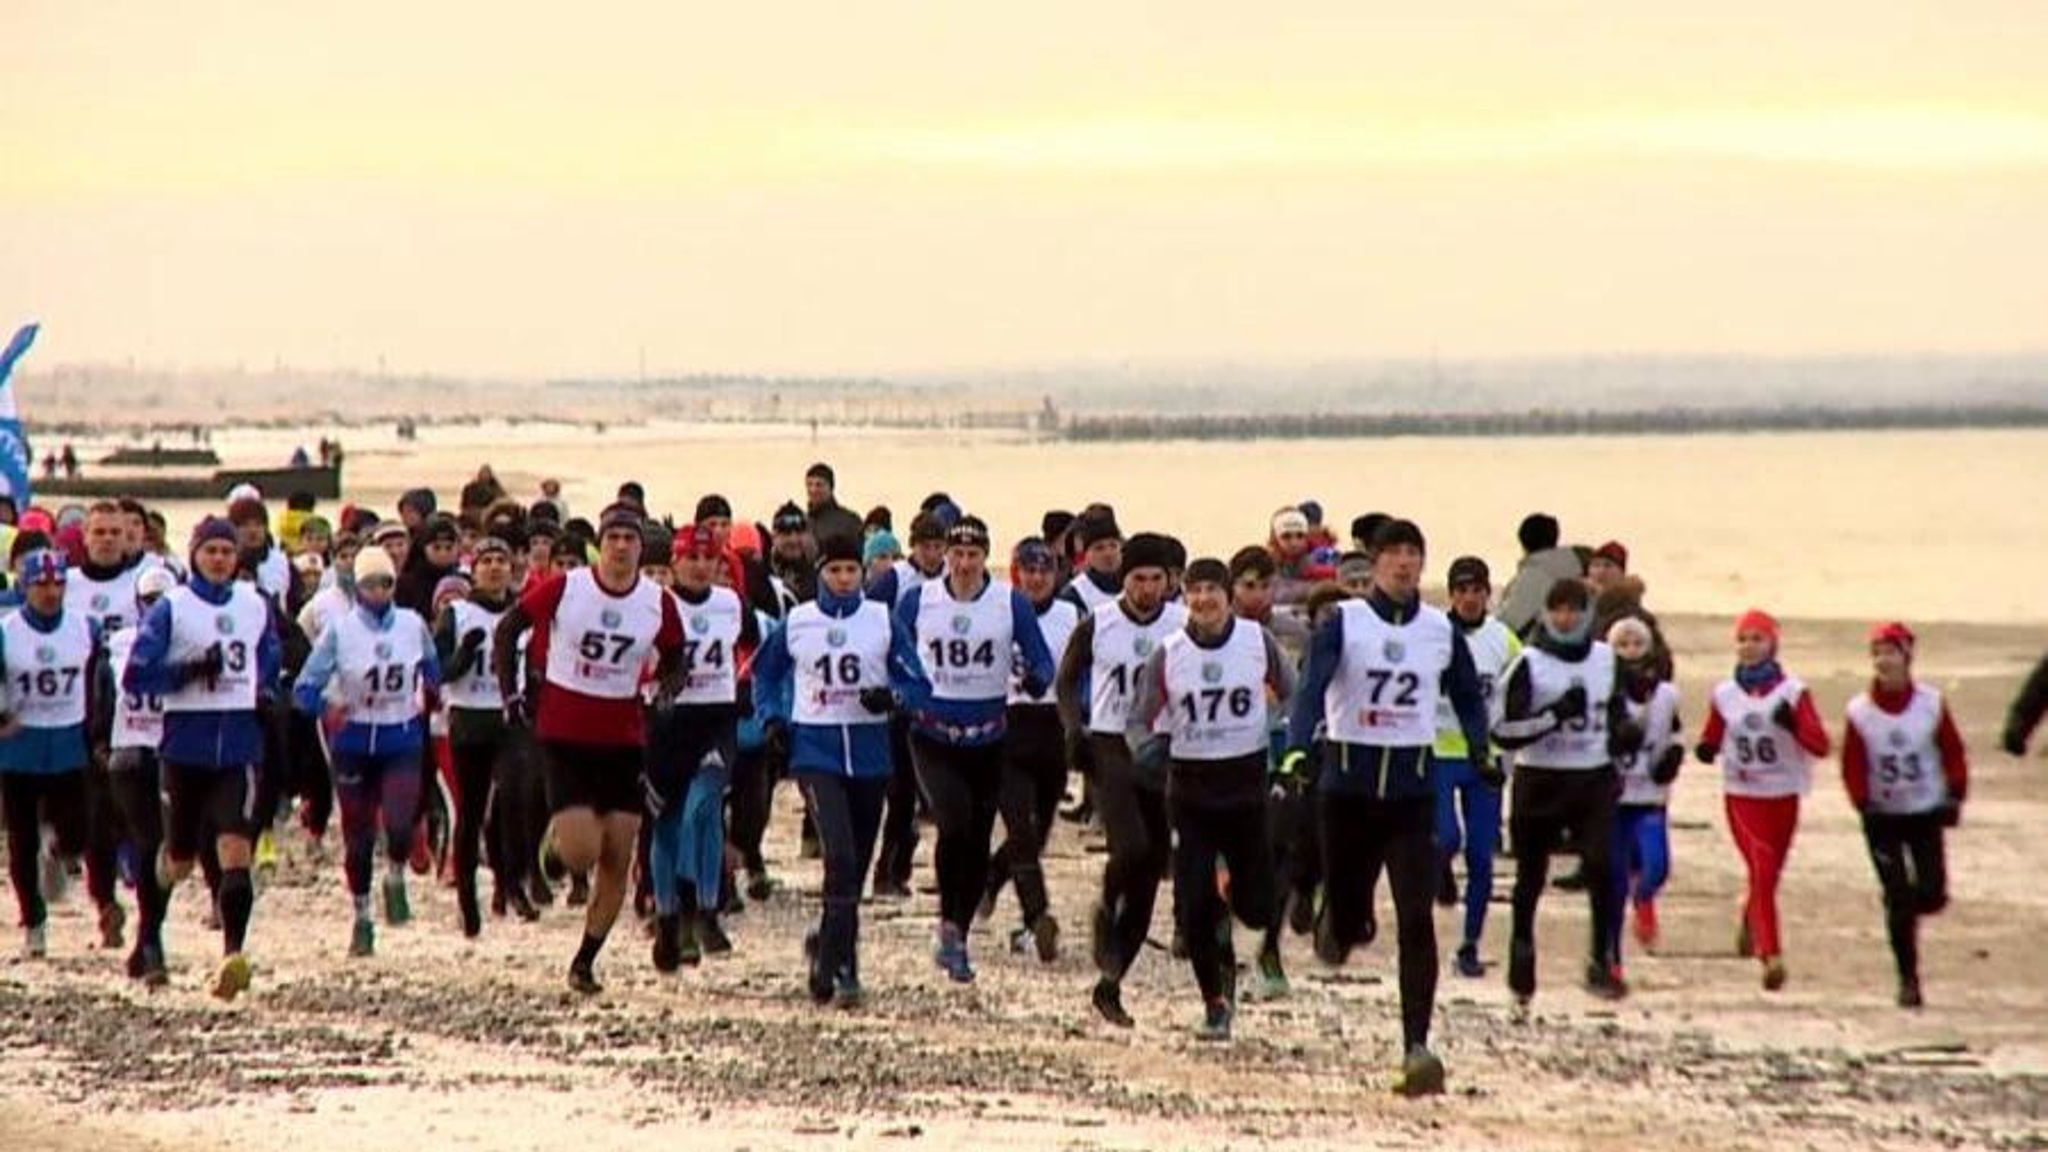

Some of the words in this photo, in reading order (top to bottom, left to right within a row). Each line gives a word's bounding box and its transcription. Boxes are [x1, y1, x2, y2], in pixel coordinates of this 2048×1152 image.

[580, 630, 635, 664] 57
[685, 640, 723, 669] 74
[929, 638, 995, 669] 184
[16, 667, 80, 696] 167
[364, 663, 404, 692] 15
[814, 653, 861, 686] 16
[1366, 669, 1419, 706] 72
[1181, 687, 1252, 723] 176
[1880, 753, 1922, 783] 53
